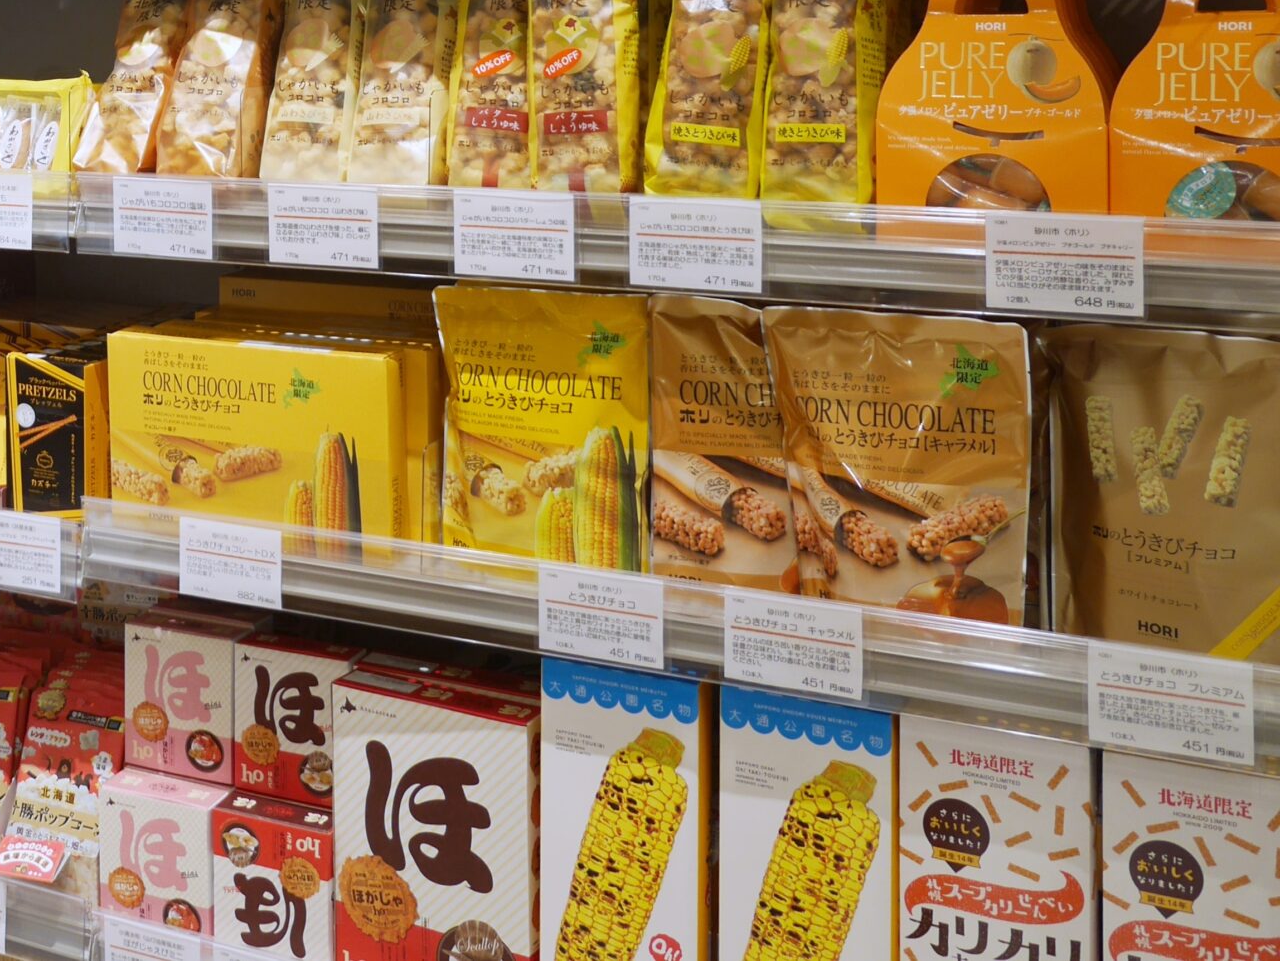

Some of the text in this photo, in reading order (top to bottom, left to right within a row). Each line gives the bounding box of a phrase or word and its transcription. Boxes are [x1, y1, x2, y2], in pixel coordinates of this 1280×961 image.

[975, 22, 1006, 31] HORI
[1218, 22, 1252, 31] HORI
[473, 50, 515, 76] 10%OFF
[543, 49, 580, 77] 10%OFF
[919, 42, 1006, 70] PURE
[1156, 42, 1251, 72] PURE
[539, 80, 609, 96] じゃがいも
[917, 71, 1005, 102] JELLY
[1155, 73, 1250, 106] JELLY
[554, 97, 595, 108] コロコロ
[669, 90, 746, 110] じゃがいも
[771, 91, 849, 107] じゃがいも
[555, 110, 595, 120] バター
[683, 109, 731, 121] コロコロ
[785, 108, 833, 120] コロコロ
[943, 104, 1022, 120] ピュアゼリー
[549, 119, 600, 133] しょうゆ味
[672, 126, 739, 143] 焼きとうきび味
[777, 125, 844, 141] 焼きとうきび味
[170, 244, 187, 253] 471
[331, 252, 350, 261] 471
[521, 264, 542, 274] 471
[704, 275, 727, 286] 471
[1074, 296, 1103, 308] 648
[950, 357, 990, 372] 北海道
[143, 370, 276, 405] CORN CHOCOLATE
[503, 368, 624, 402] CHOCOLATE
[956, 371, 983, 385] 限定
[18, 382, 77, 402] PRETZELS
[679, 379, 739, 408] CORN
[143, 392, 241, 416] ホリのとうきびチョコ
[856, 400, 997, 436] CHOCOLATE
[31, 479, 59, 488] カズチー
[1091, 524, 1237, 562] ホリのとうきびチョコ
[568, 592, 637, 610] とうきびチョコ
[1118, 588, 1201, 611] ホワイトチョコレート
[733, 615, 856, 641] とうきびチョコ キャラメル
[1137, 619, 1180, 639] HORI
[610, 647, 631, 659] 451
[144, 643, 212, 723] ほ
[801, 677, 826, 689] 451
[1100, 670, 1246, 702] とうきびチョコ プレミアム
[254, 664, 326, 746] ほ
[549, 680, 693, 717] 大通公園名物
[729, 708, 884, 750] 大通公園名物
[1181, 739, 1211, 755] 451
[949, 748, 1035, 780] 北海道限定
[240, 763, 265, 785] ho
[962, 770, 1021, 787] HOKKAIDO LIMITED
[40, 785, 77, 805] 北海道
[1157, 787, 1254, 821] 北海道限定
[364, 738, 495, 895] ほ
[939, 807, 972, 822] さらに
[1173, 810, 1238, 829] HOKKAIDO LIMITED
[929, 816, 982, 838] おいしく
[119, 809, 188, 892] ほ
[938, 849, 976, 866] 誕生14年
[1147, 851, 1184, 867] さらに
[1136, 860, 1196, 883] おいしく
[351, 889, 404, 908] ほがじゃ
[1145, 894, 1189, 912] 誕生14年
